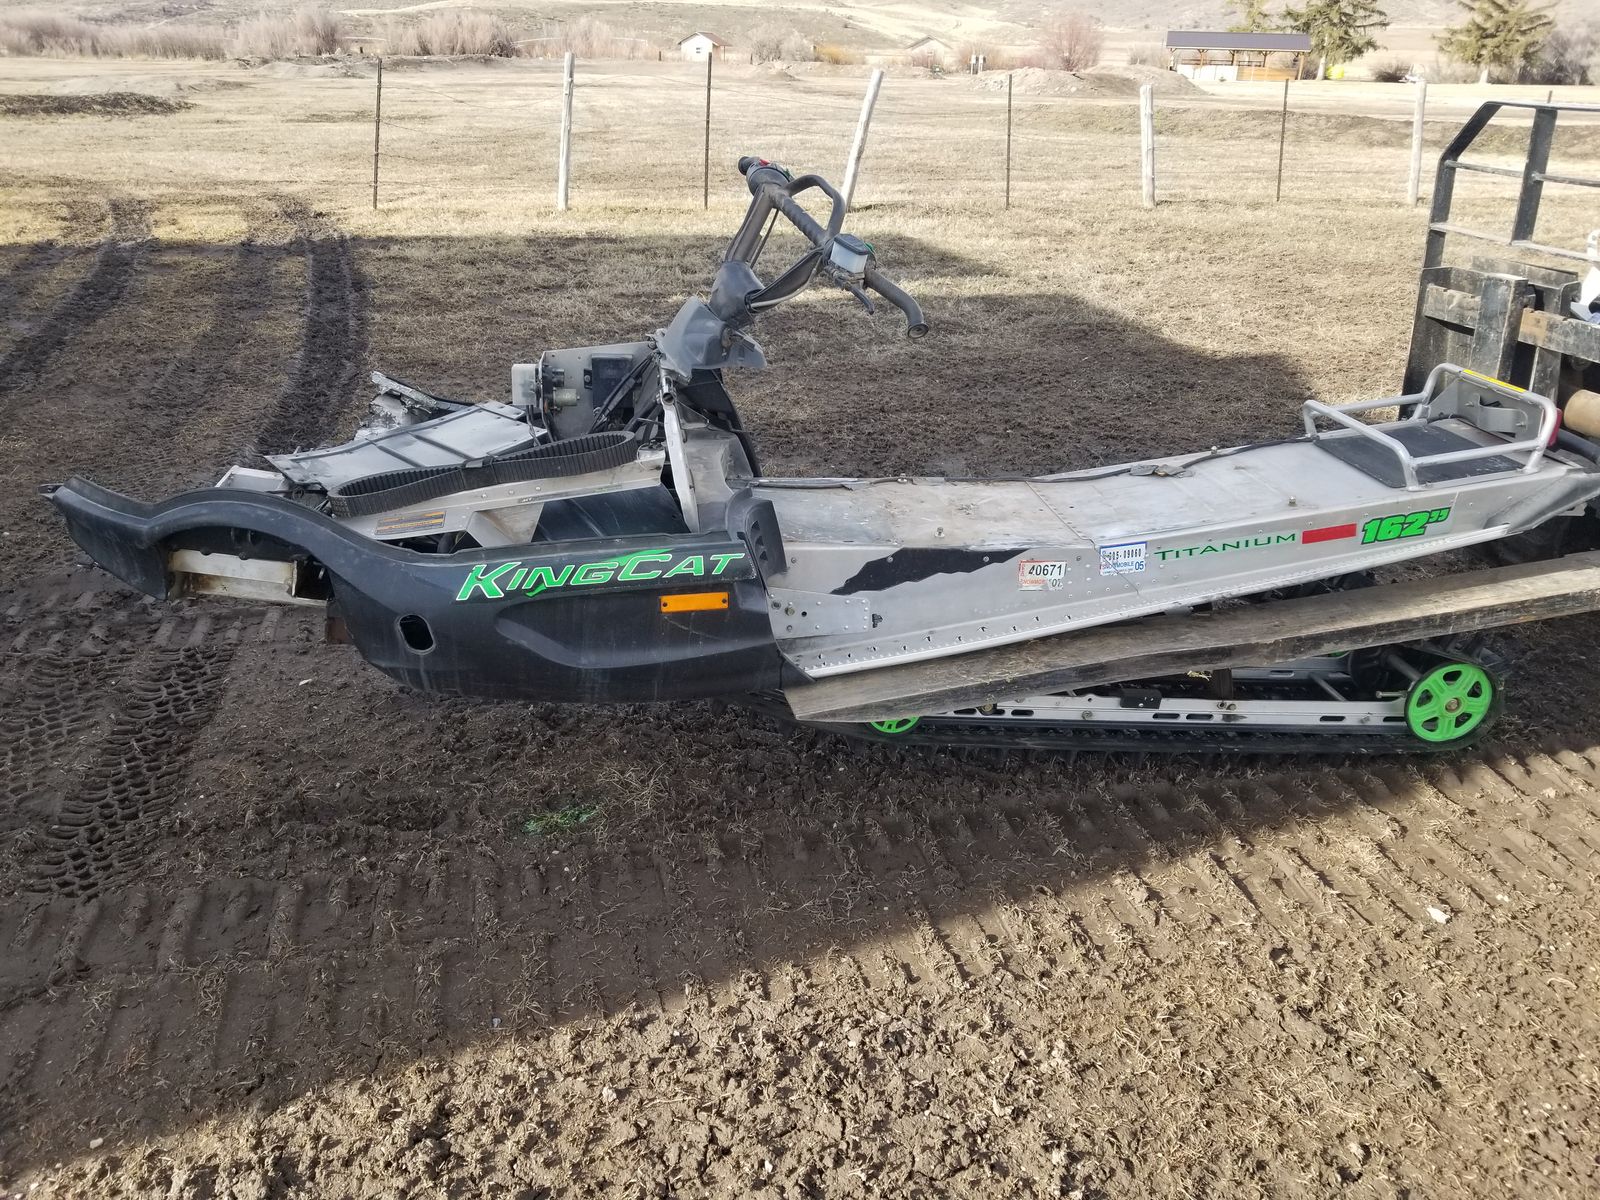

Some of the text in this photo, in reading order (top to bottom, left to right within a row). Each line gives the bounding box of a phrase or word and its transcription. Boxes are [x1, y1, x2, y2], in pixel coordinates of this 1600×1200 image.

[1154, 533, 1297, 561] TITANIUM
[1028, 564, 1062, 576] 40671
[1134, 561, 1144, 571] 05
